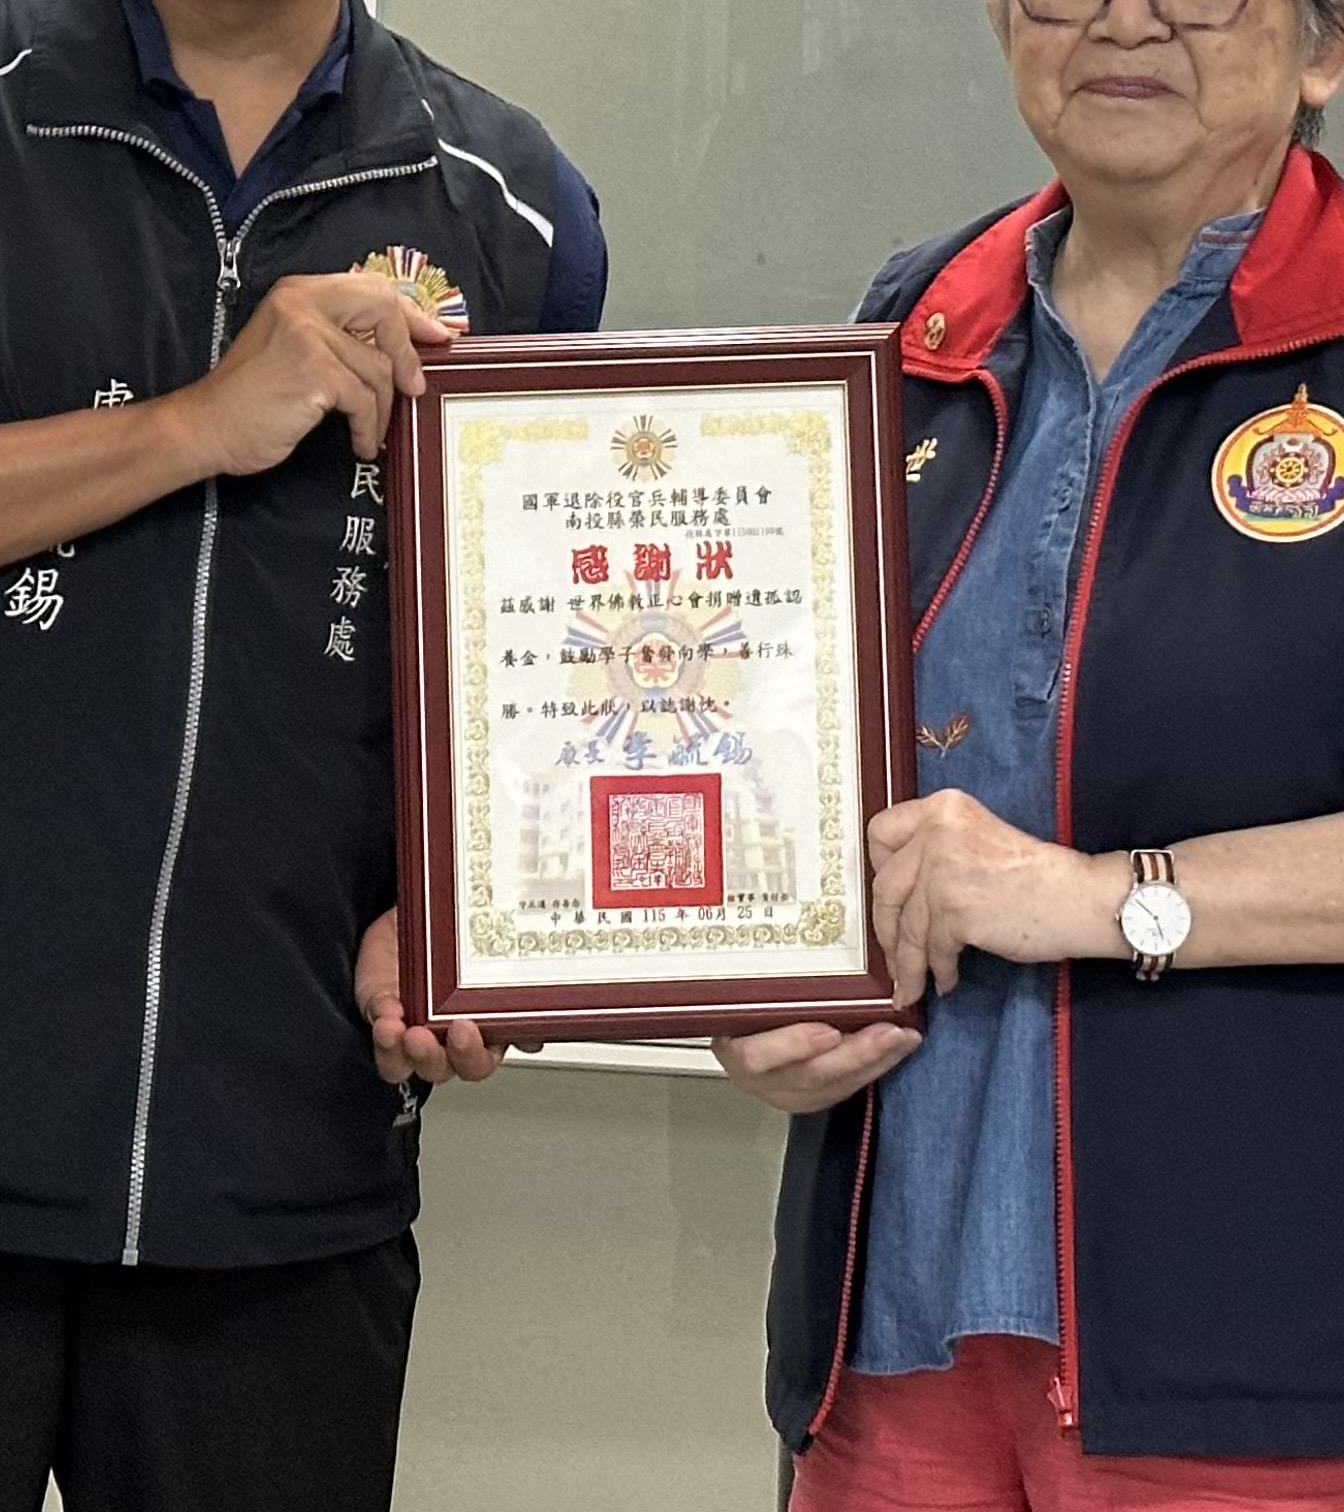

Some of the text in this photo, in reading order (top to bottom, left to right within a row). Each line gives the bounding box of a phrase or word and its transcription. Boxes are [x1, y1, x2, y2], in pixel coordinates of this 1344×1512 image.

[522, 485, 772, 511] 國軍退除役官兵輔導委員會
[565, 508, 731, 530] 南投縣榮民服務處
[571, 540, 734, 585] 感謝狀
